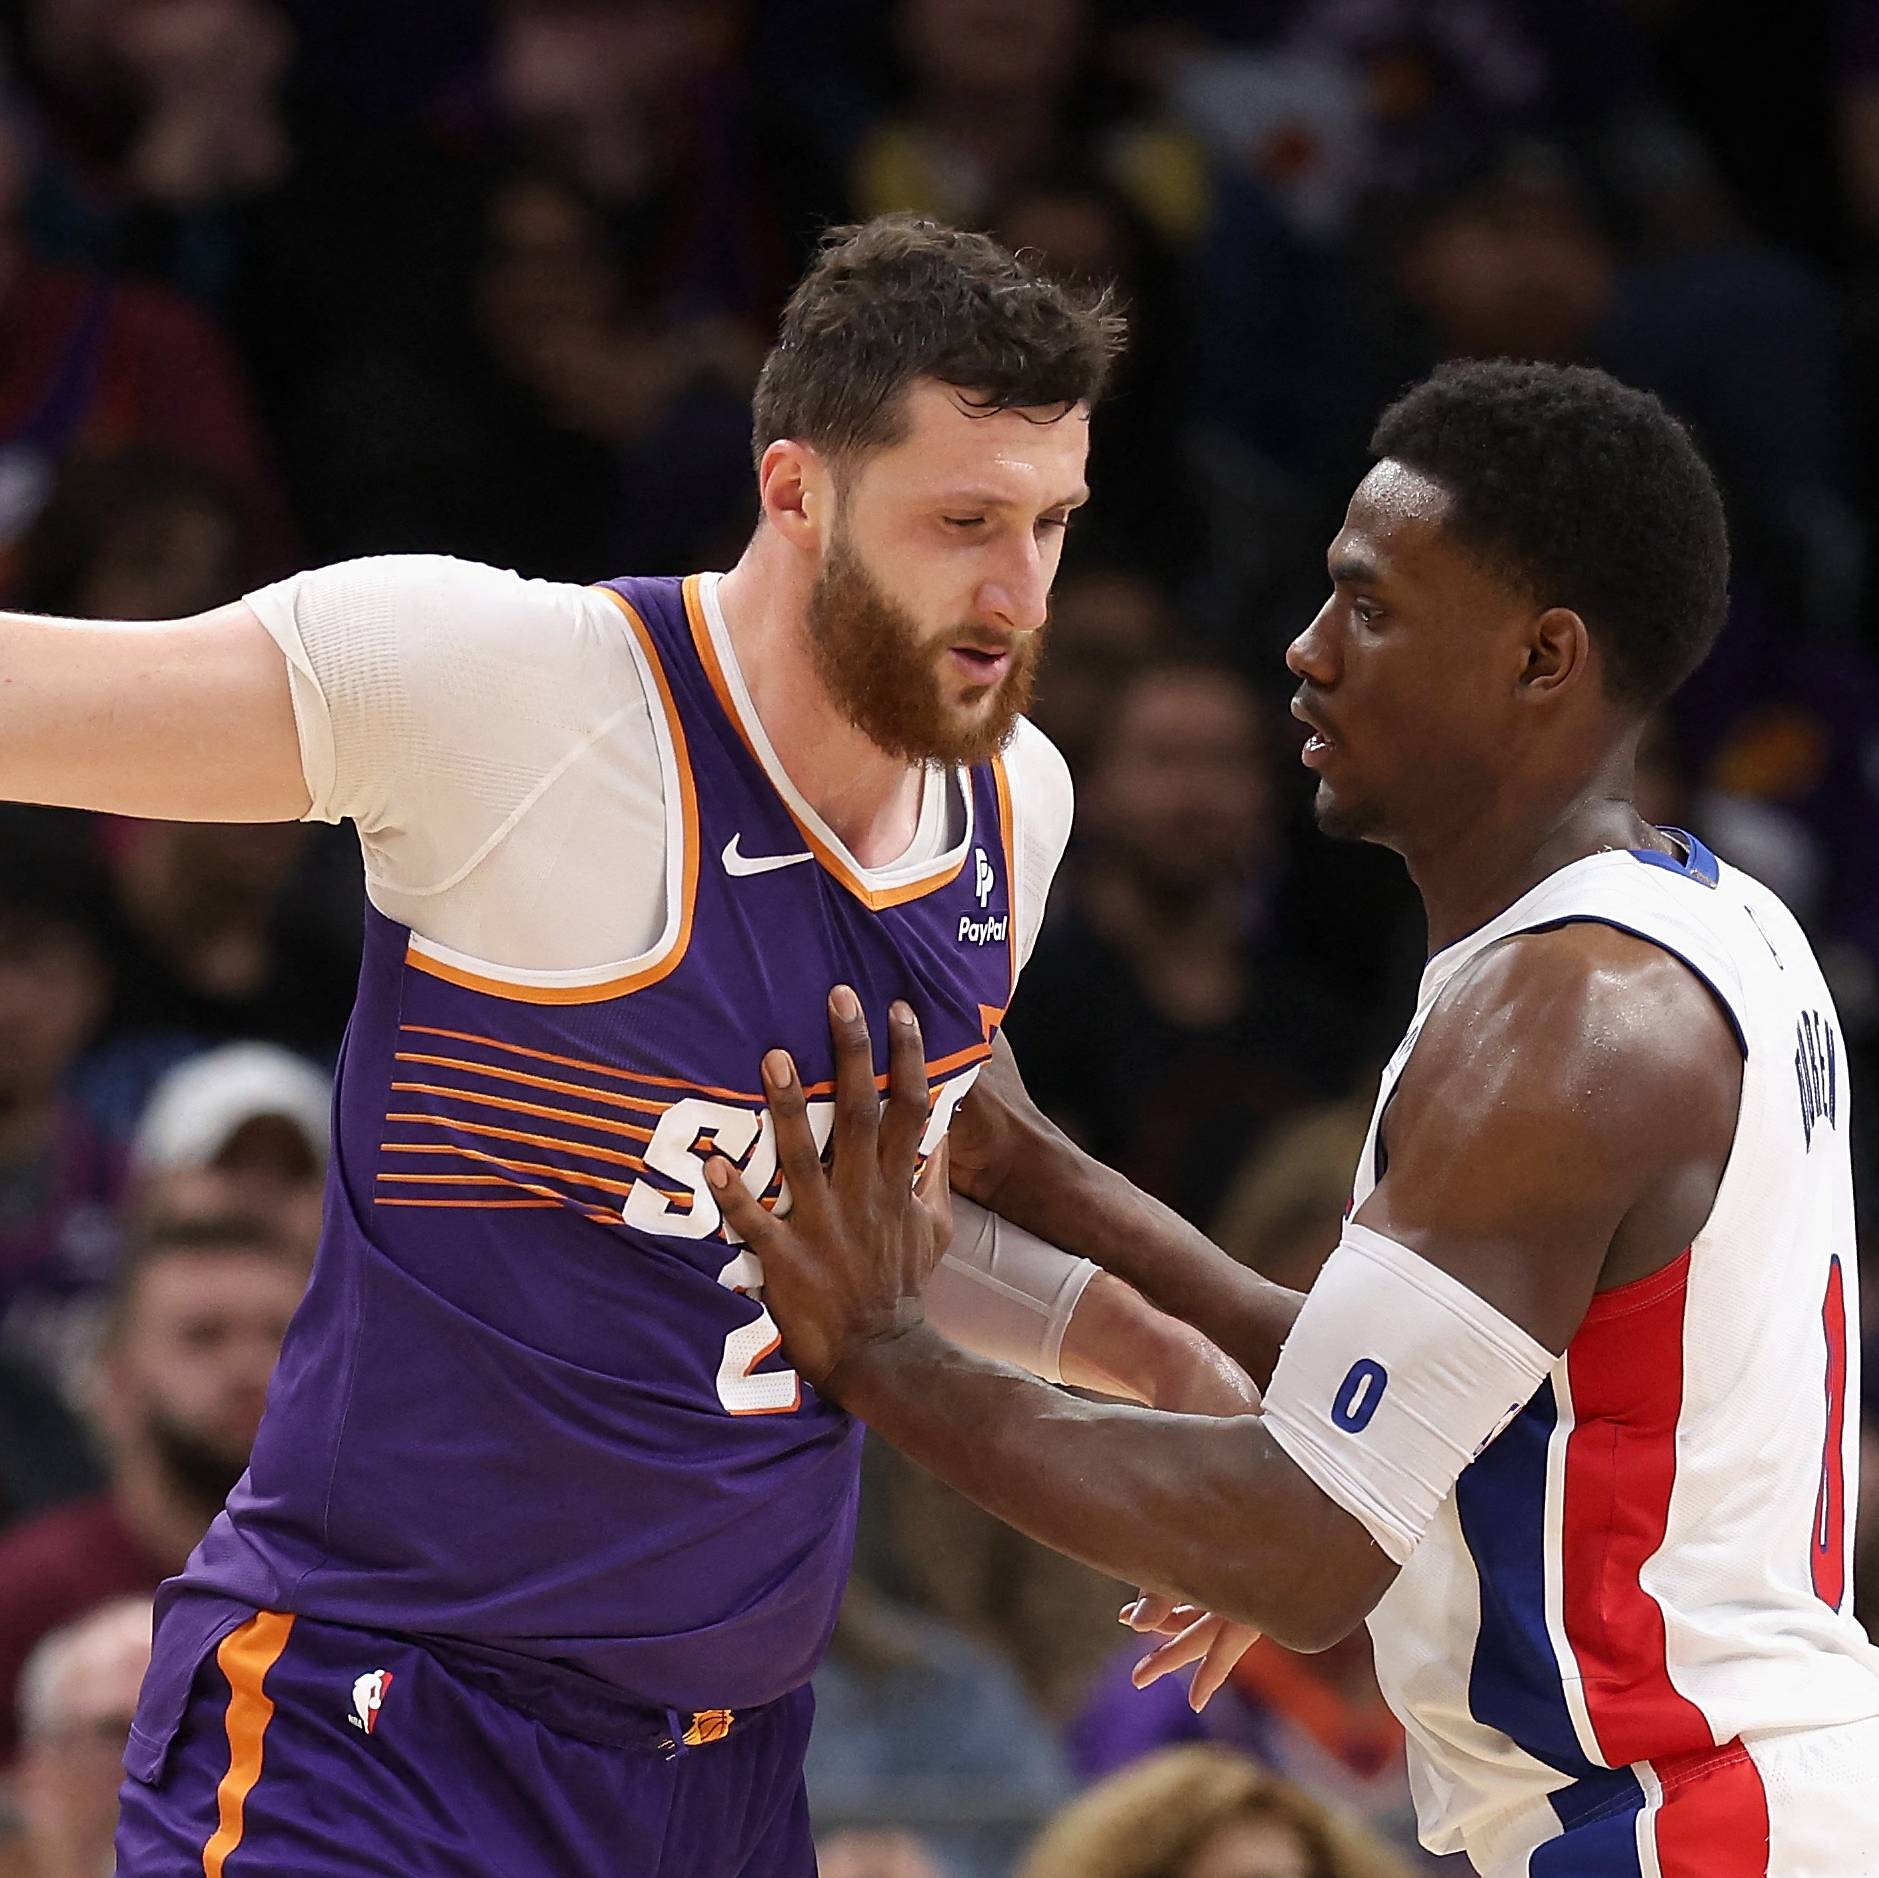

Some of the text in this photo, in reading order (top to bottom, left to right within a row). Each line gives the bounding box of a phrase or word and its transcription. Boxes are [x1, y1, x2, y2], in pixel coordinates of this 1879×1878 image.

[958, 915, 1008, 946] PayPal
[716, 1249, 802, 1416] 2
[1331, 1358, 1388, 1434] 0
